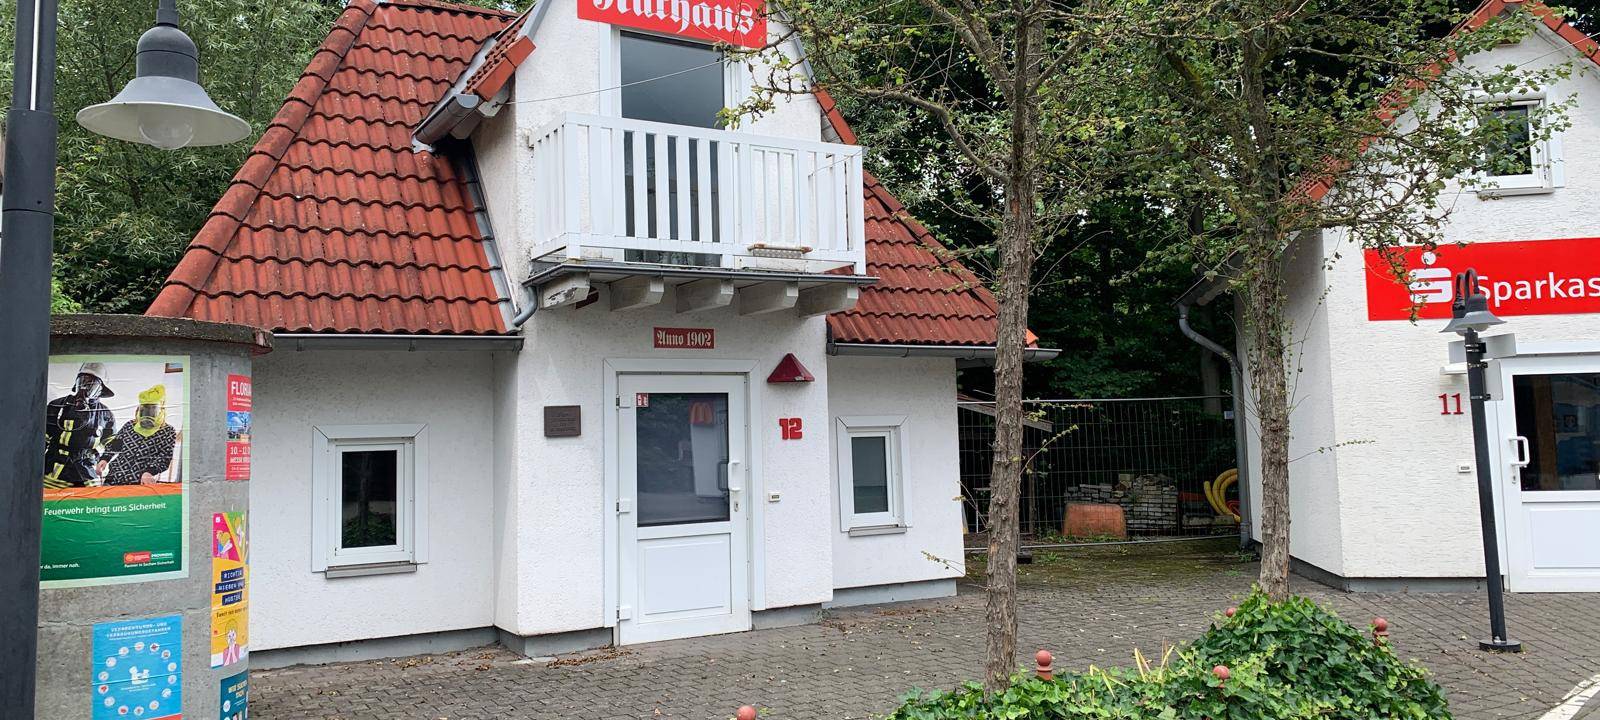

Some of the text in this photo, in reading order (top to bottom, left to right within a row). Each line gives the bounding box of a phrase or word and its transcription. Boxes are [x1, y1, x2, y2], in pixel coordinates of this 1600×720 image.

[656, 330, 712, 347] Anno 1902
[1438, 393, 1464, 415] 11
[779, 417, 803, 440] 12
[44, 502, 166, 516] Feuerwehr bringt uns Sicherheit
